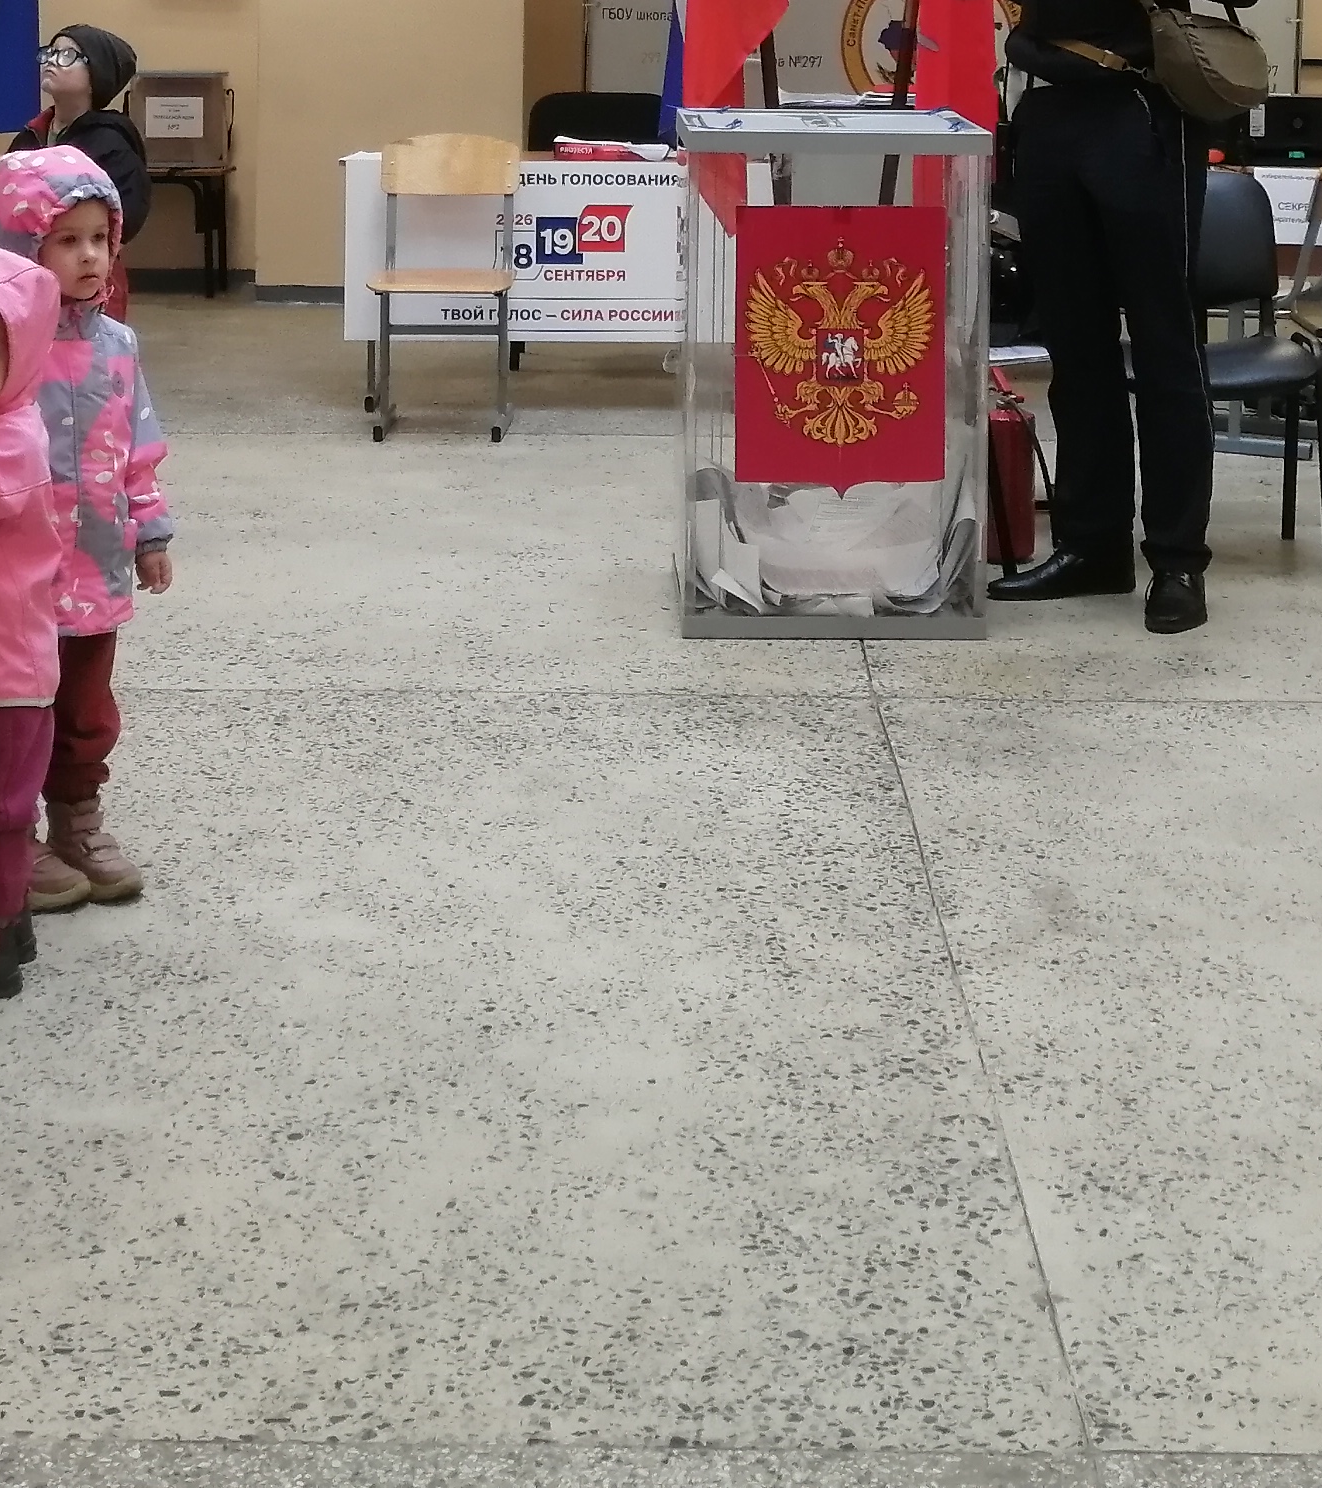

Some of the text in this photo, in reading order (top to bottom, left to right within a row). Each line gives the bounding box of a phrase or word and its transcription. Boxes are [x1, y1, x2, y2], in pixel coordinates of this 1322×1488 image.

[602, 7, 633, 21] ГБОУ
[561, 174, 679, 186] ГОЛОСОВАНИЯ
[495, 214, 533, 226] 226
[540, 228, 574, 255] 19
[581, 216, 623, 242] 20
[543, 270, 626, 281] СЕНТЯБРЯ
[441, 306, 485, 321] ТВОЙ
[488, 309, 542, 322] ГЛОС
[560, 309, 605, 322] СИЛА
